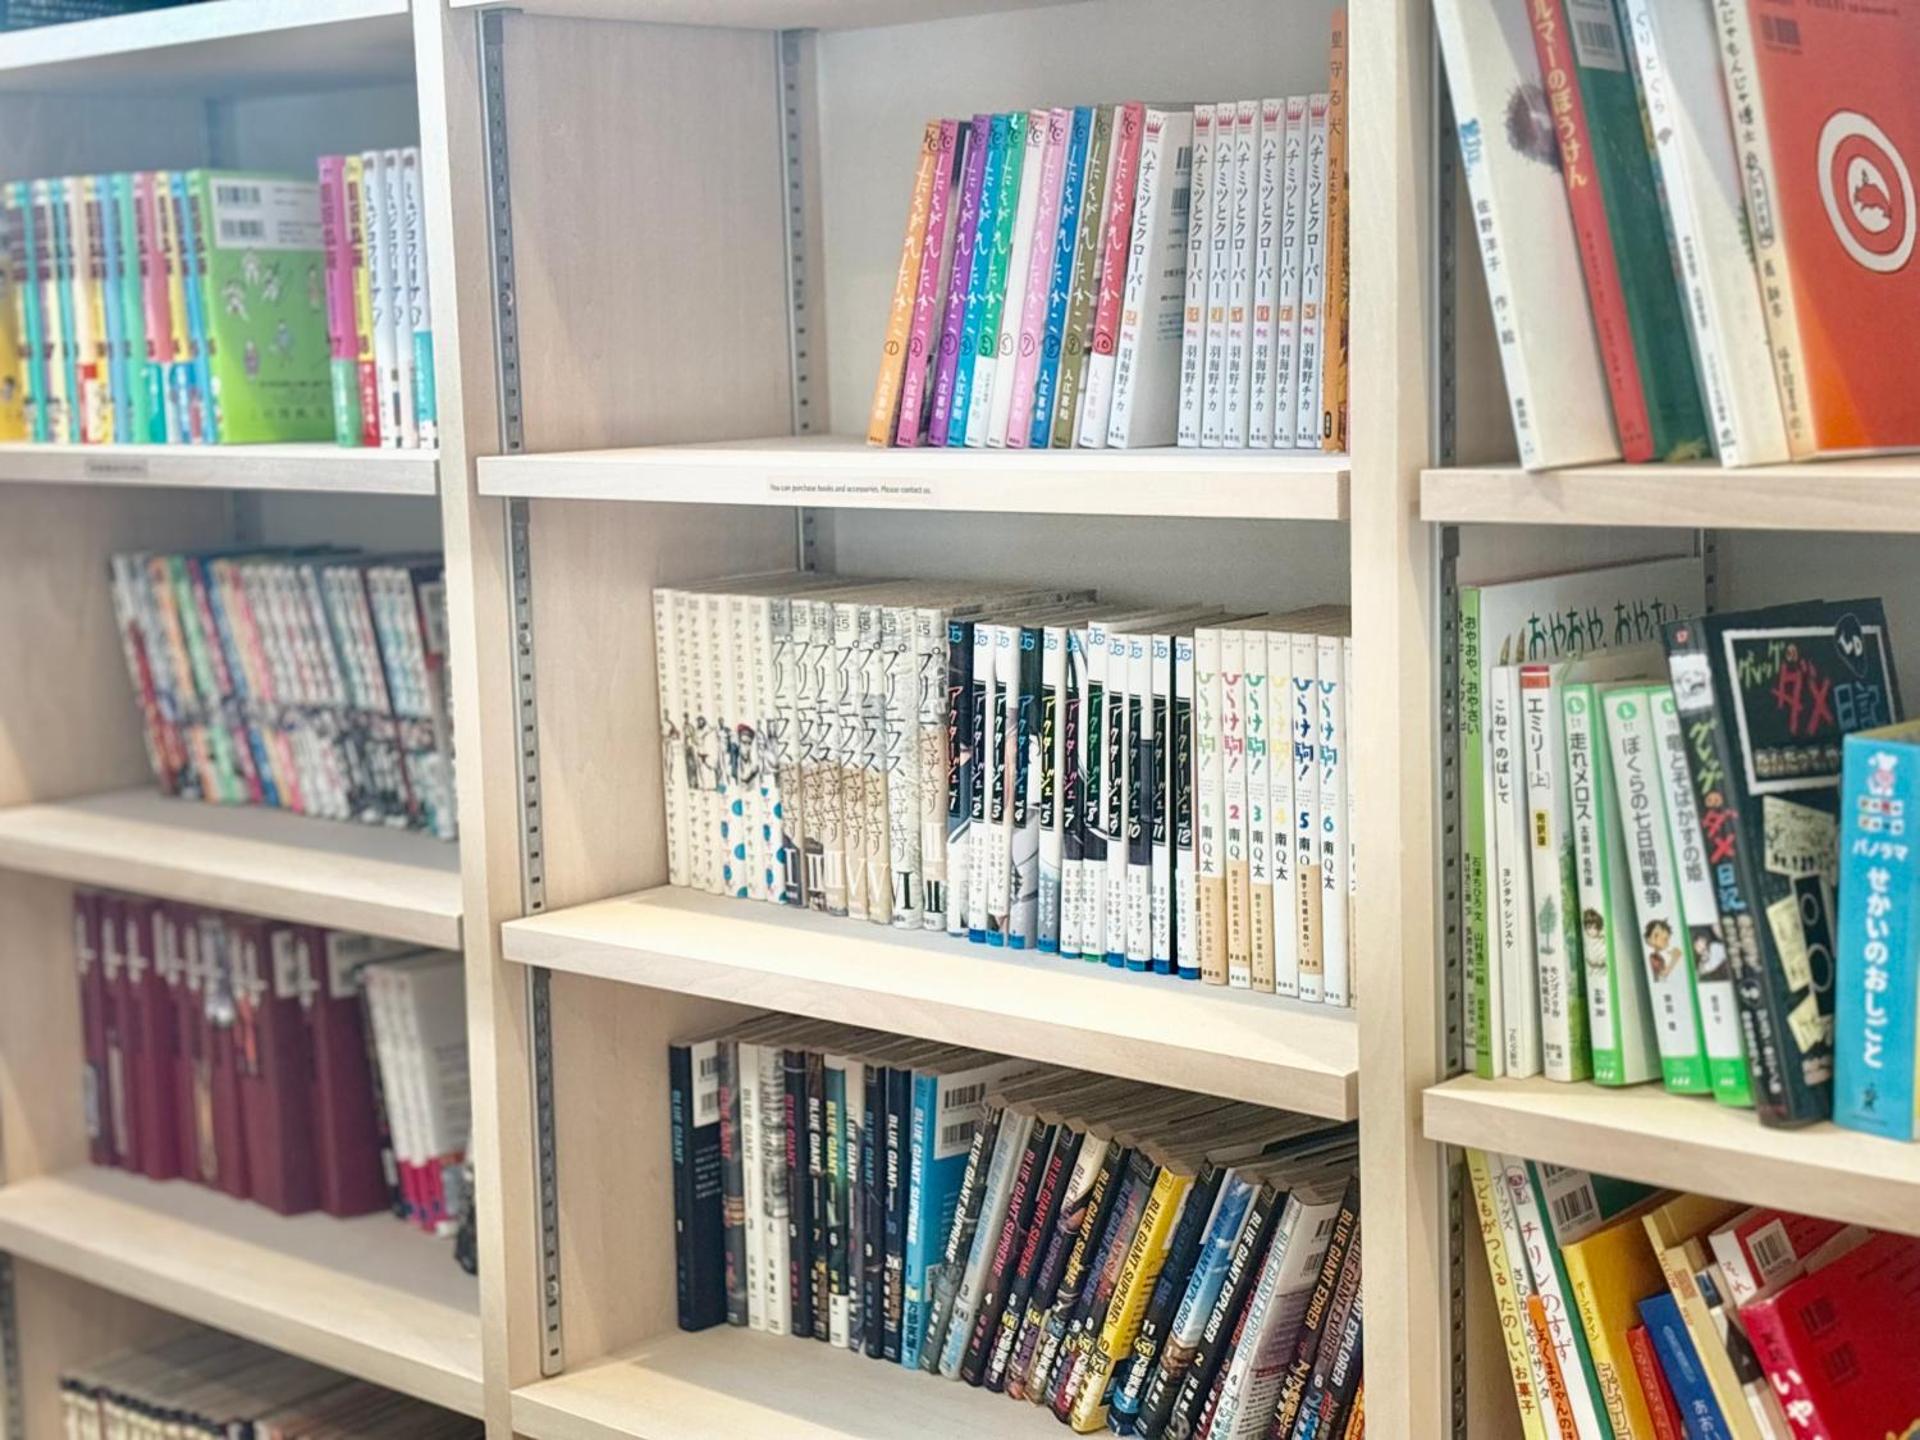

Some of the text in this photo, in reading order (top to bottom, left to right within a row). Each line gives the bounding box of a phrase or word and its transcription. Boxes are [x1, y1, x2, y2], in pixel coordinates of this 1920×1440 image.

[1129, 149, 1157, 303] ハチミツとクローバー
[1187, 143, 1208, 299] ハチミツとクローバー
[1212, 142, 1231, 299] ハチミツとクローバー
[1232, 140, 1250, 299] ハチミツとクローバー
[1257, 139, 1277, 298] ハチミツとクローバー
[1281, 138, 1300, 297] ハチミツとクローバー
[1304, 134, 1324, 295] ハチミツとクローバー
[835, 484, 846, 493] and
[881, 485, 899, 494] Please
[901, 486, 922, 494] contact
[1195, 671, 1217, 772] ひらけ駒！
[1221, 671, 1244, 775] ひらけ駒！
[1293, 676, 1314, 830] ひらけ駒！ 5
[1494, 699, 1510, 805] こねて のばして
[1229, 804, 1241, 820] 2
[1245, 672, 1267, 879] ひらけ駒！ 3 南Q太
[1318, 679, 1338, 891] ひらけ駒！ 6 南Q太
[1570, 732, 1592, 821] 走れメロス
[1621, 735, 1662, 908] ぼくらの七日間戦争
[1201, 825, 1214, 873] 南Q太
[1275, 832, 1289, 881] 南Q太
[1852, 837, 1909, 862] パノラマ
[1862, 866, 1892, 1069] せかいのおしごと
[809, 1097, 820, 1132] BLUE
[809, 1132, 821, 1176] GIANT
[887, 1113, 899, 1188] BLUE GIANT
[826, 1100, 839, 1246] BLUE GIANT 6
[847, 1142, 858, 1183] GIANT
[907, 1106, 924, 1245] BLUE GIANT SUPREME
[945, 1132, 984, 1265] BLUE GIANT SUPREME
[1034, 1154, 1063, 1229] BLUE GIANT
[1080, 1167, 1111, 1240] BLUE GIANT
[992, 1147, 1037, 1278] BLUE GIANT SUPREME
[1131, 1197, 1161, 1271] BLUE GIANT
[1244, 1210, 1263, 1249] BLUE
[1320, 1208, 1354, 1284] BLUE GIANT
[1174, 1275, 1202, 1336] EXPLORER
[1228, 1247, 1249, 1286] GIANT
[1473, 1168, 1508, 1287] こどもがつくる
[1499, 1297, 1525, 1362] たのしい
[1522, 1220, 1573, 1363] チリンのすず
[1142, 1319, 1156, 1335] 11
[1193, 1352, 1204, 1367] 2
[1202, 1282, 1234, 1344] EXPLORER
[1331, 1315, 1360, 1388] EXPLORER
